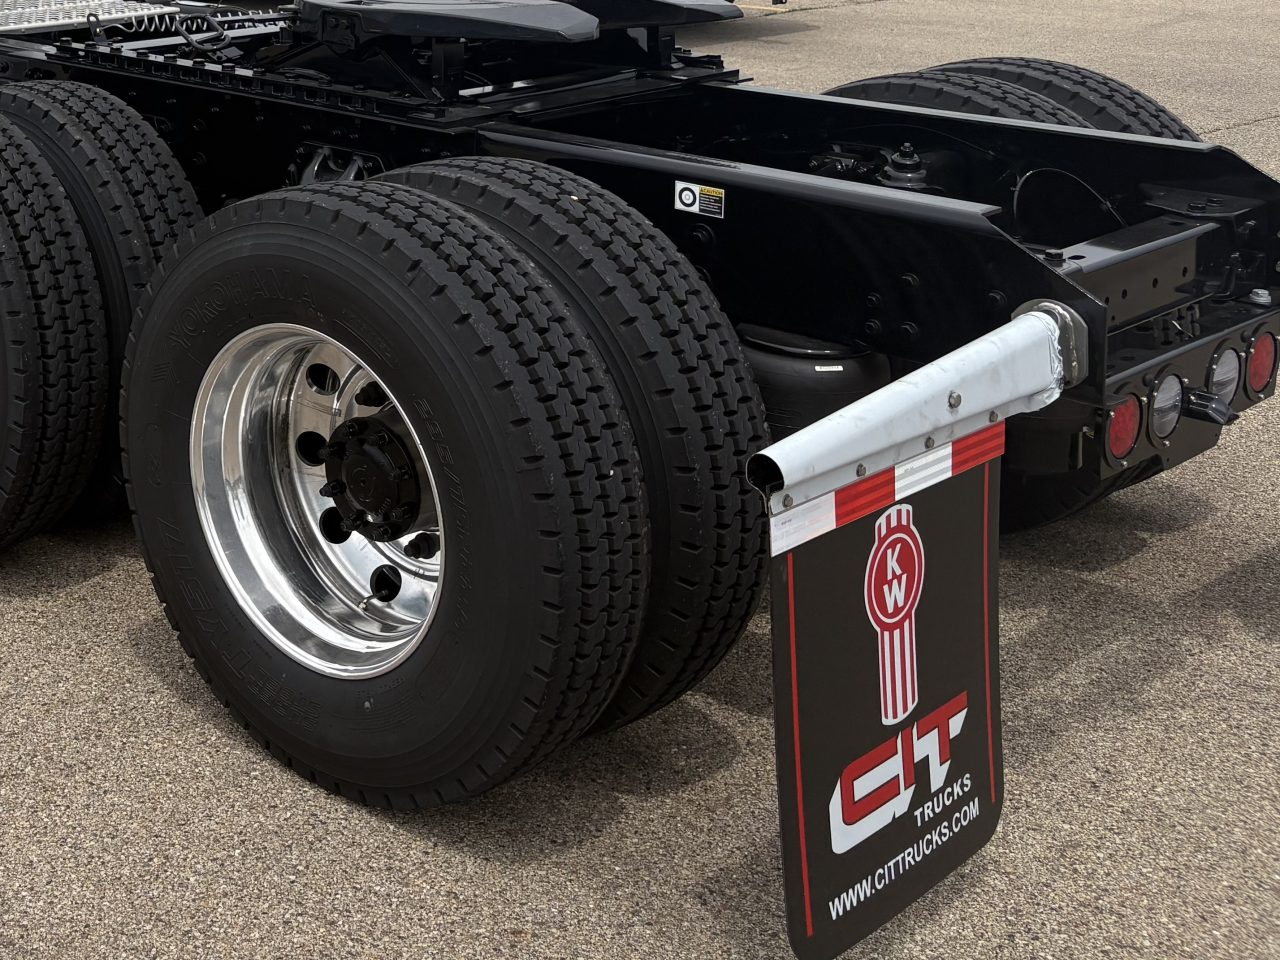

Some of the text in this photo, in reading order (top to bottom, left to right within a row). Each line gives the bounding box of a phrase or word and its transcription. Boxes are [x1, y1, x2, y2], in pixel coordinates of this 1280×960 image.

[886, 542, 903, 581] K
[883, 573, 908, 614] W
[829, 691, 969, 855] CIT
[914, 773, 972, 827] TRUCKS
[828, 796, 981, 921] WWW.CITTRUCKS.COM
